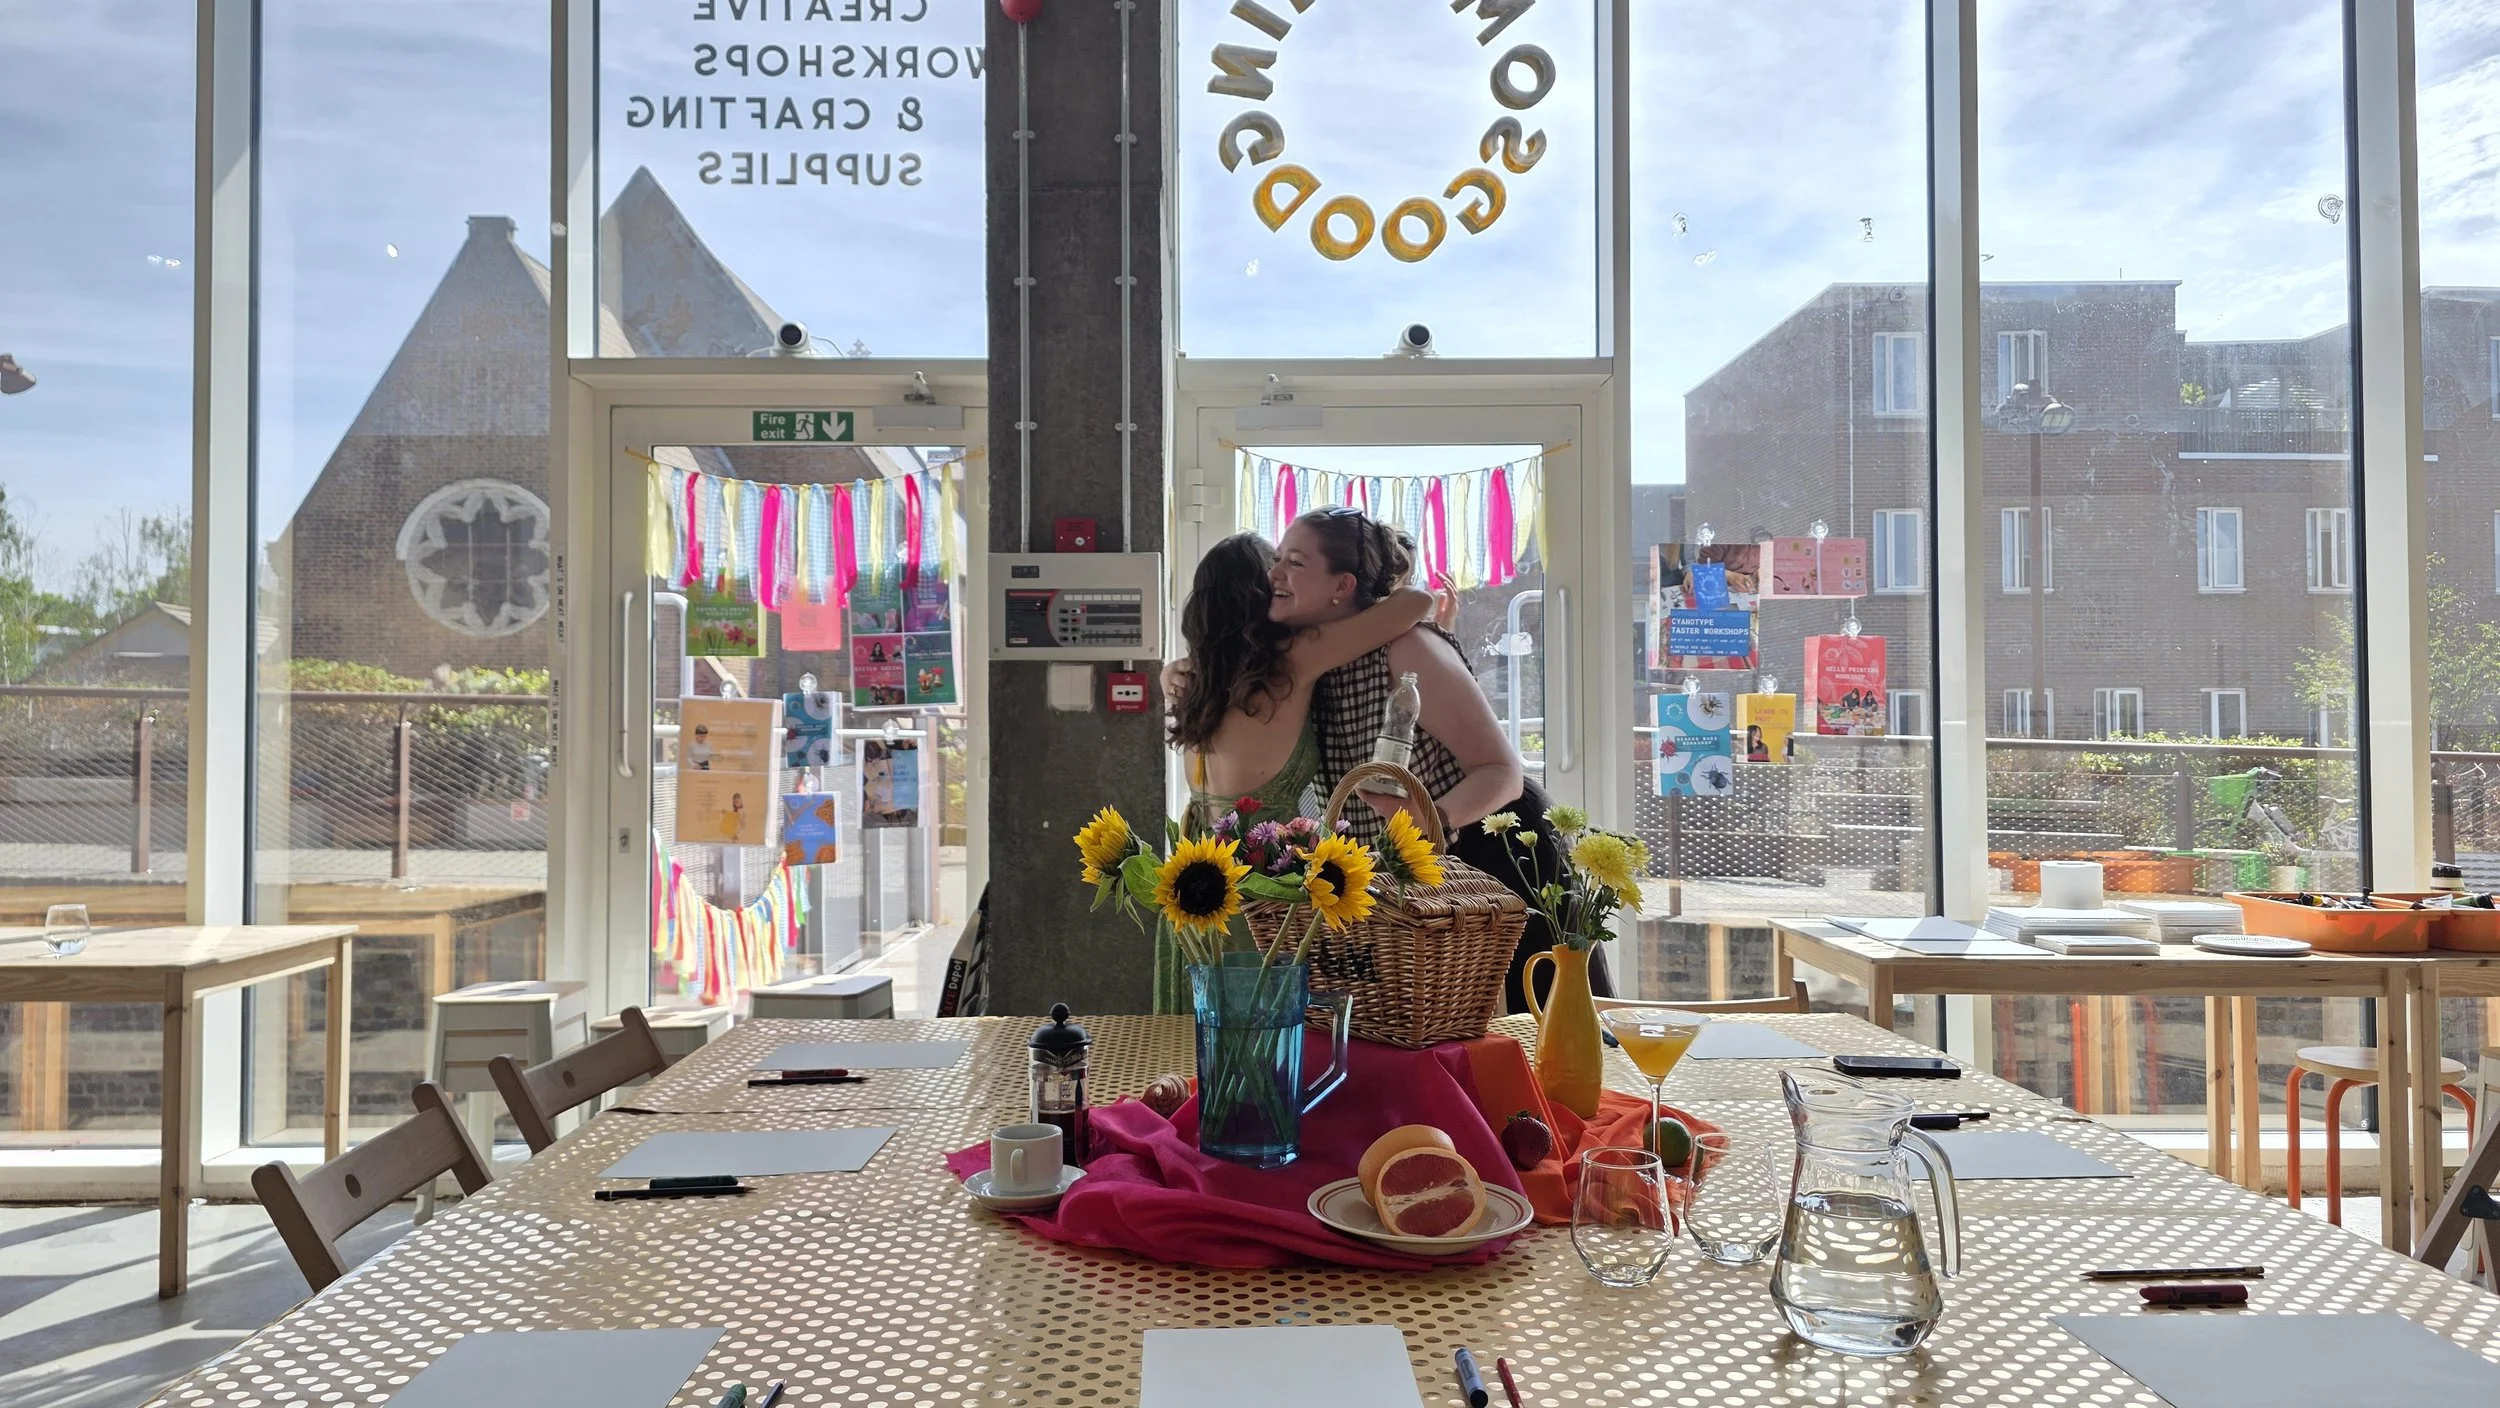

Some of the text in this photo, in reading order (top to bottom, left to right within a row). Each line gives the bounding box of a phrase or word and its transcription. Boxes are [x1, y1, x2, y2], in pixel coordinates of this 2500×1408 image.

[760, 413, 786, 425] Fire
[760, 428, 786, 439] exit
[557, 598, 565, 617] NEXT
[1671, 618, 1714, 626] CYANOTYPE
[552, 723, 560, 740] NEXT
